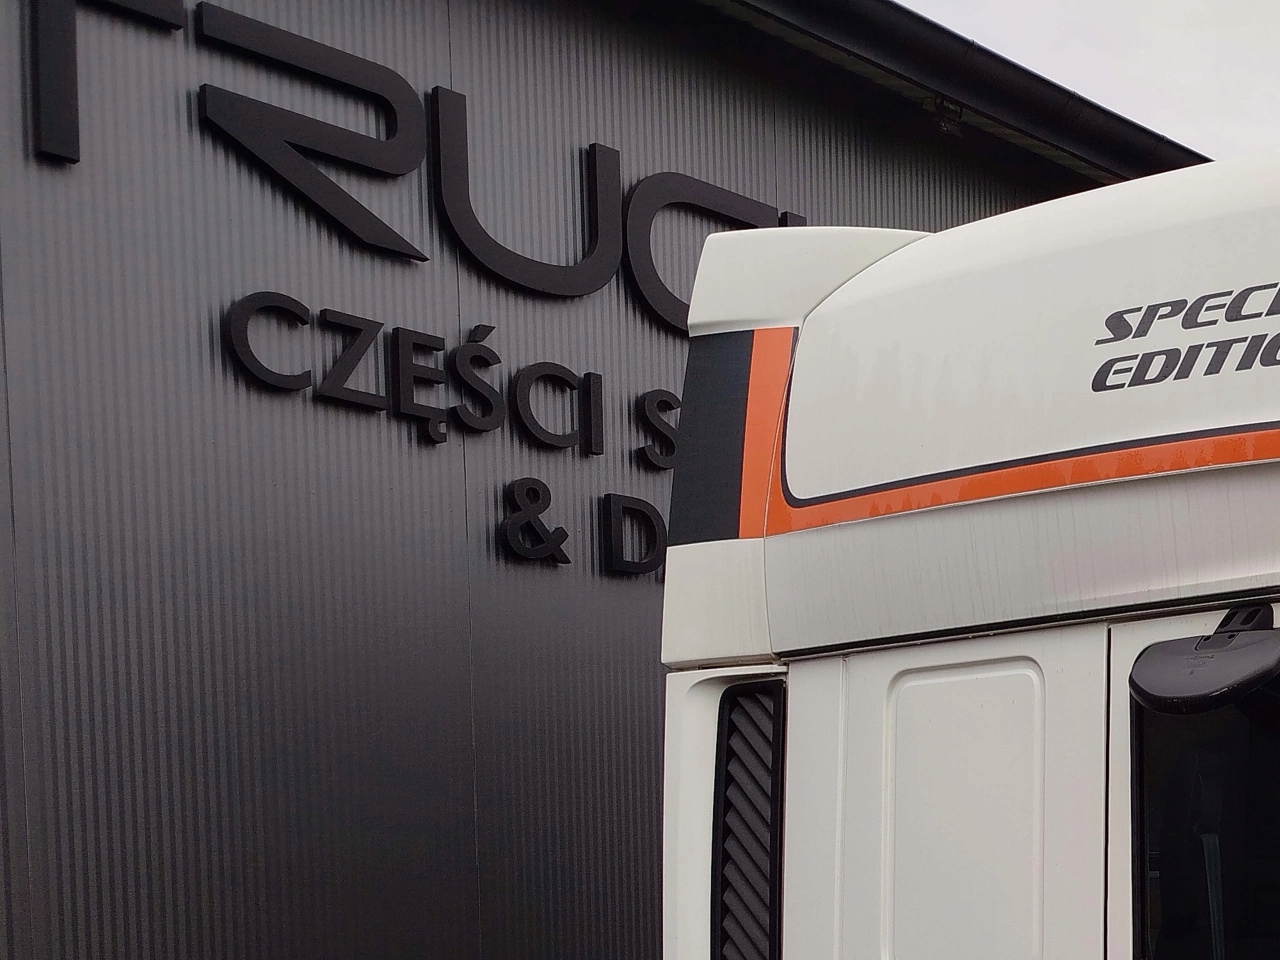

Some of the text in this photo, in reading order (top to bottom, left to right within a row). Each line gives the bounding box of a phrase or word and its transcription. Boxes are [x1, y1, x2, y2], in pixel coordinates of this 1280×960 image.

[29, 0, 806, 334] TRUC
[226, 290, 604, 457] CZĘŚCI
[503, 477, 572, 565] &
